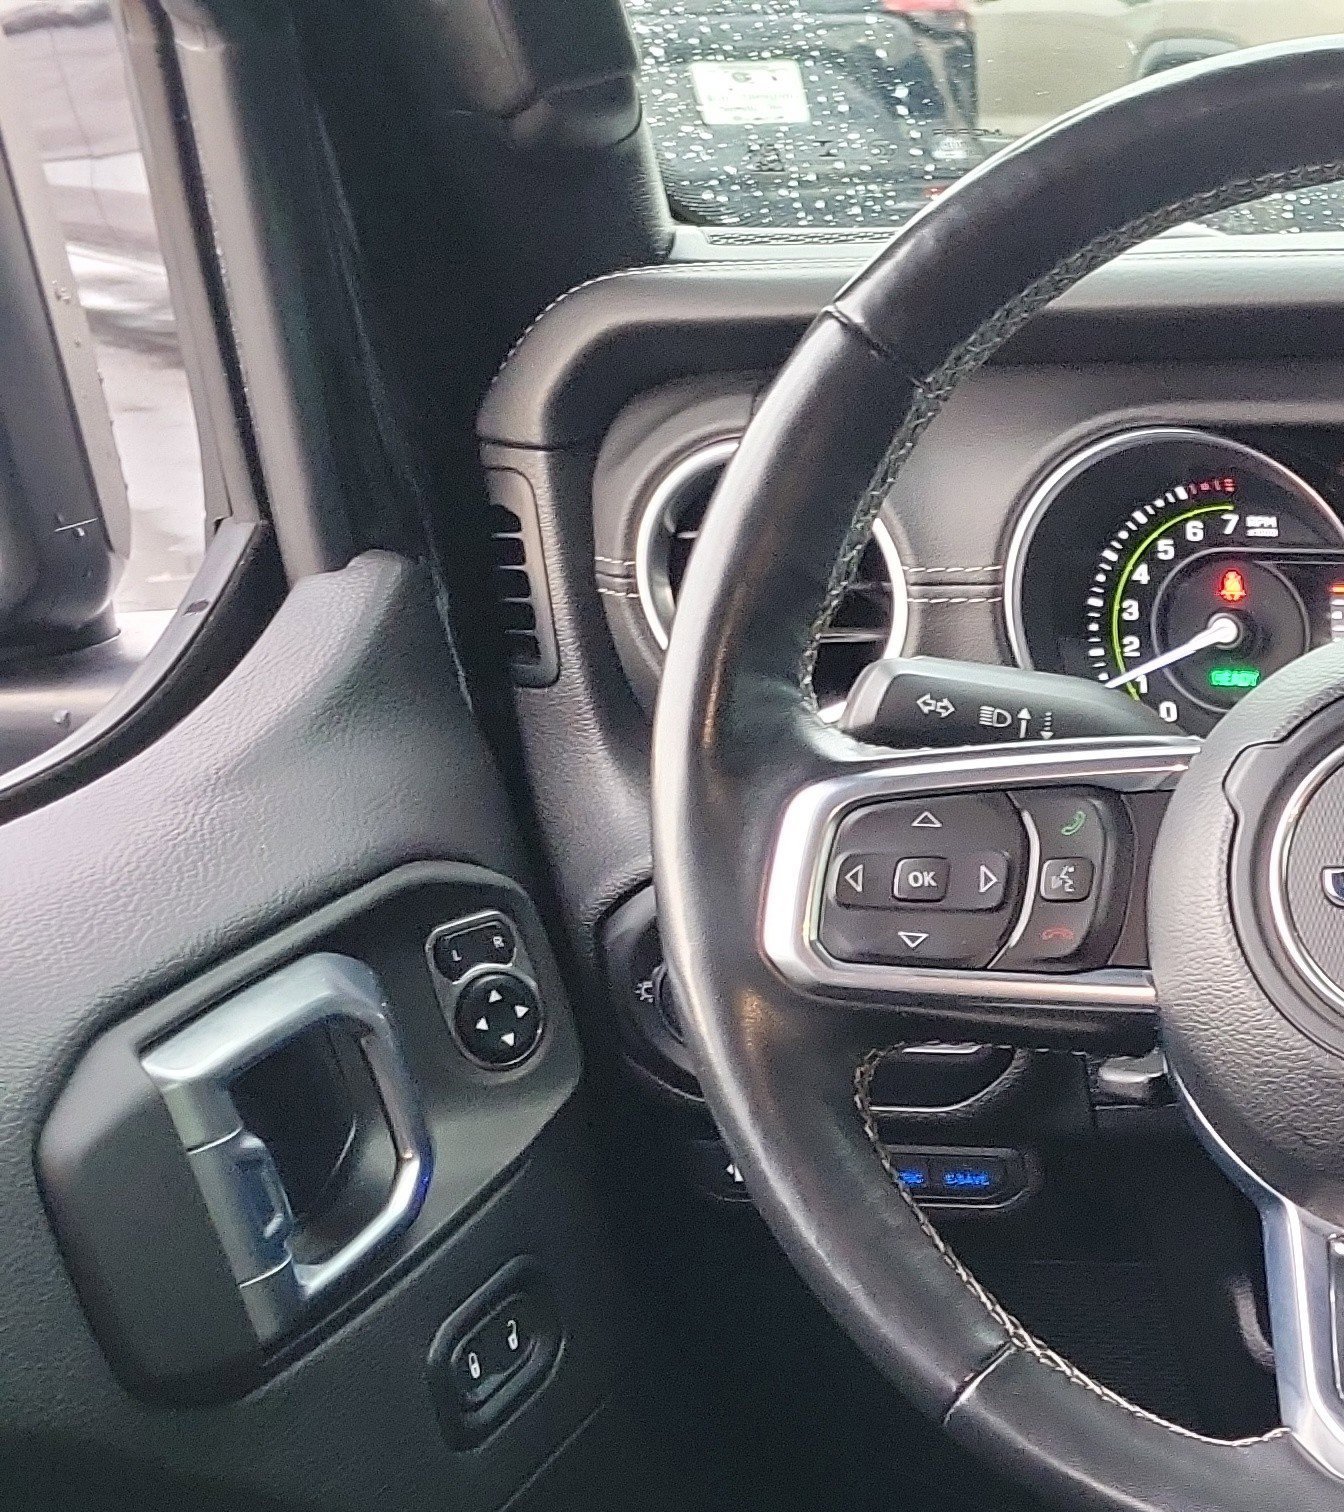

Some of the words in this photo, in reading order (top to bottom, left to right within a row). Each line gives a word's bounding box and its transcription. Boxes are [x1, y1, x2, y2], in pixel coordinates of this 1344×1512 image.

[1186, 520, 1204, 541] 6
[1222, 513, 1239, 535] 7
[1157, 540, 1175, 560] 5
[1132, 564, 1150, 585] 4
[1122, 600, 1139, 621] 3
[1123, 636, 1140, 657] 2
[1159, 701, 1177, 722] 0
[908, 870, 937, 888] OK
